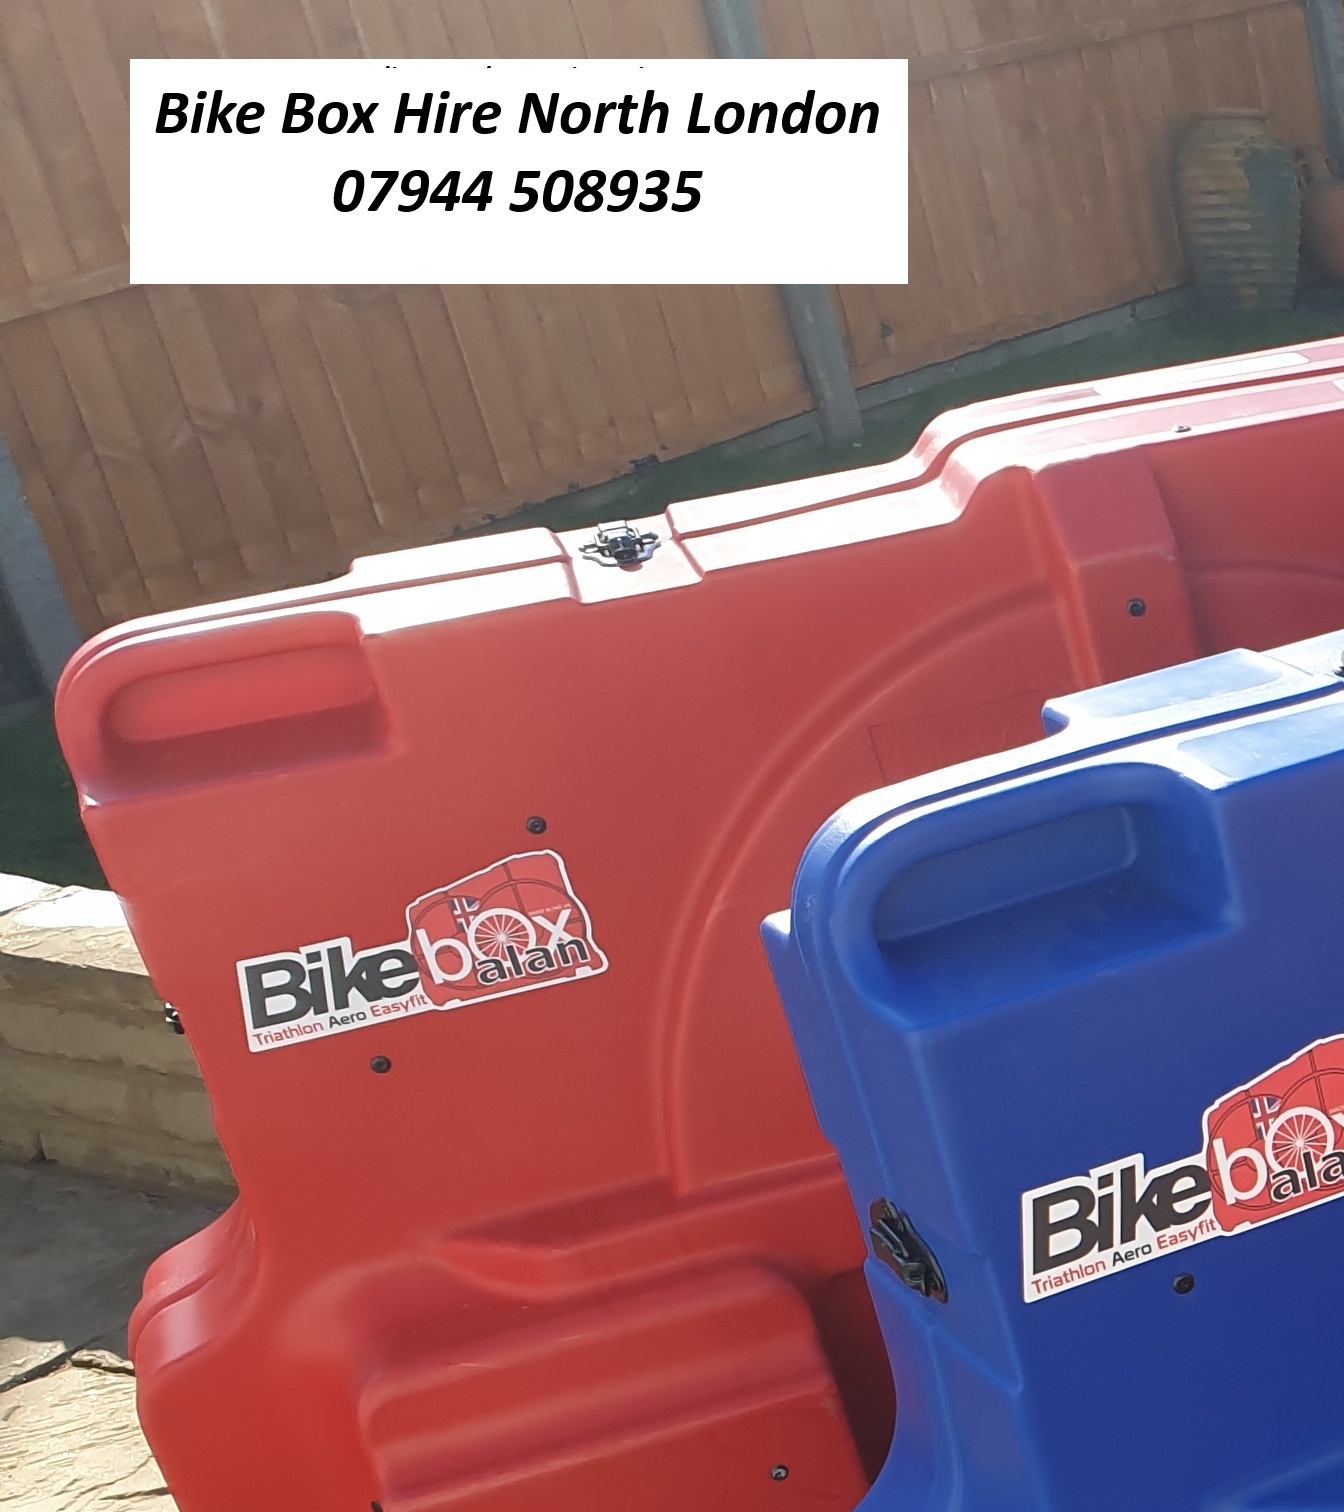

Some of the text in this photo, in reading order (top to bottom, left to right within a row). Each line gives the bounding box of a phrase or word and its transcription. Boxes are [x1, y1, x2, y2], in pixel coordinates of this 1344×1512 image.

[476, 937, 590, 985] alan
[251, 994, 428, 1047] Triathlon Aero Easyfit
[1031, 1218, 1217, 1295] Triathlon Aero Easyfit
